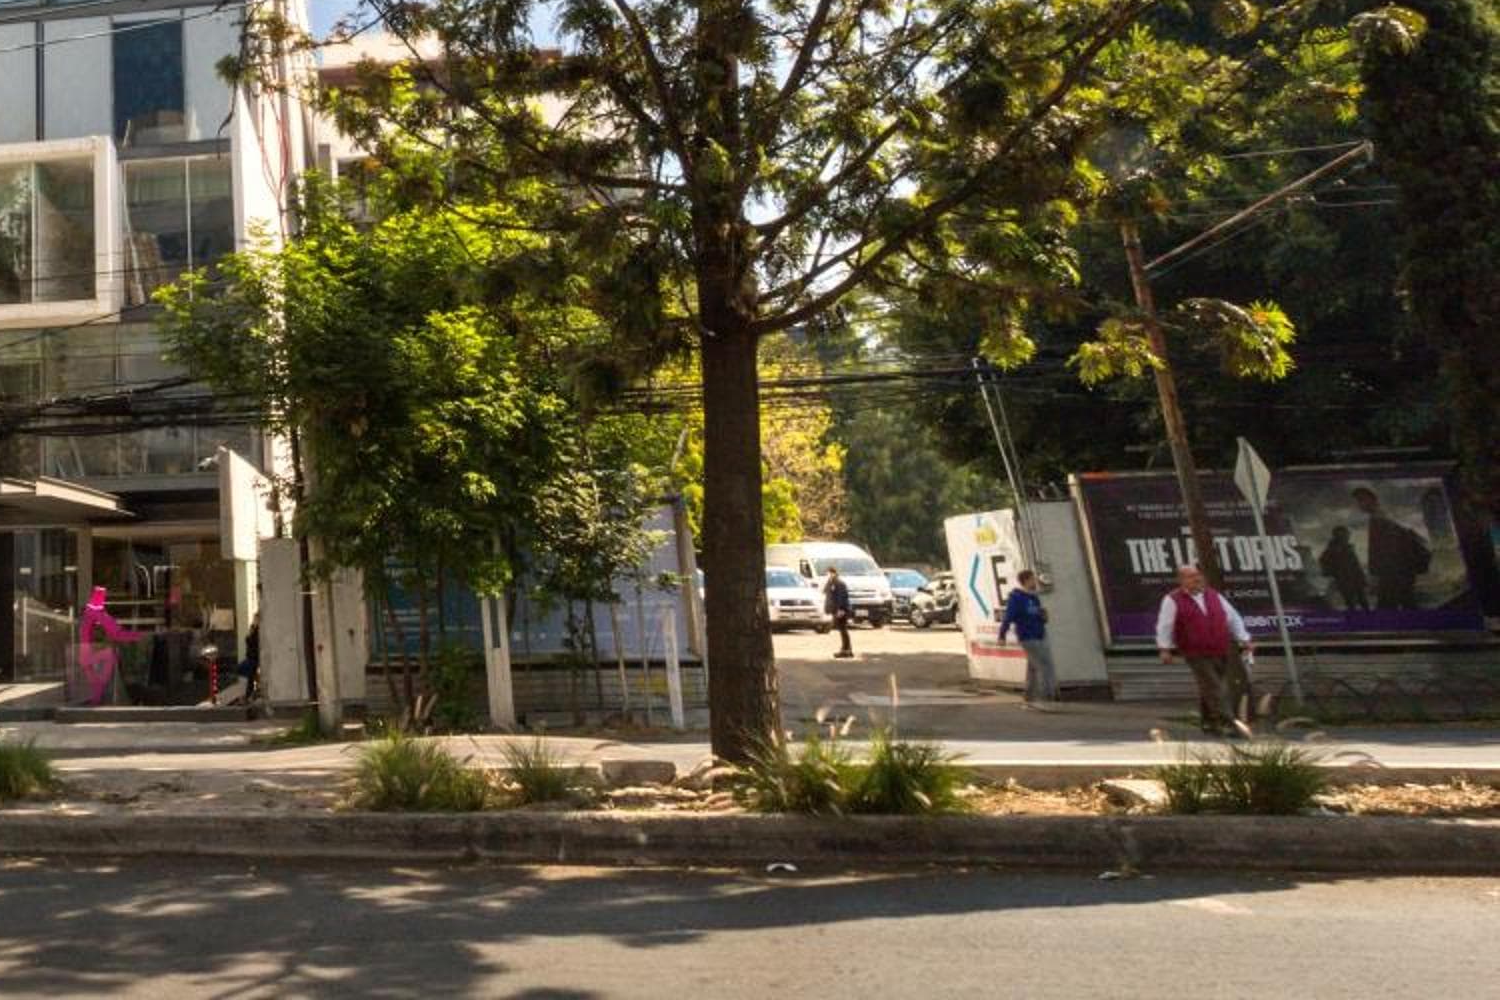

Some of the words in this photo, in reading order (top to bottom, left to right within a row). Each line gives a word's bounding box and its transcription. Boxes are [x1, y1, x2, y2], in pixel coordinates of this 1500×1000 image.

[1125, 537, 1173, 574] THE
[1171, 535, 1233, 573] LAT
[1233, 536, 1266, 572] OF
[1266, 535, 1303, 571] US
